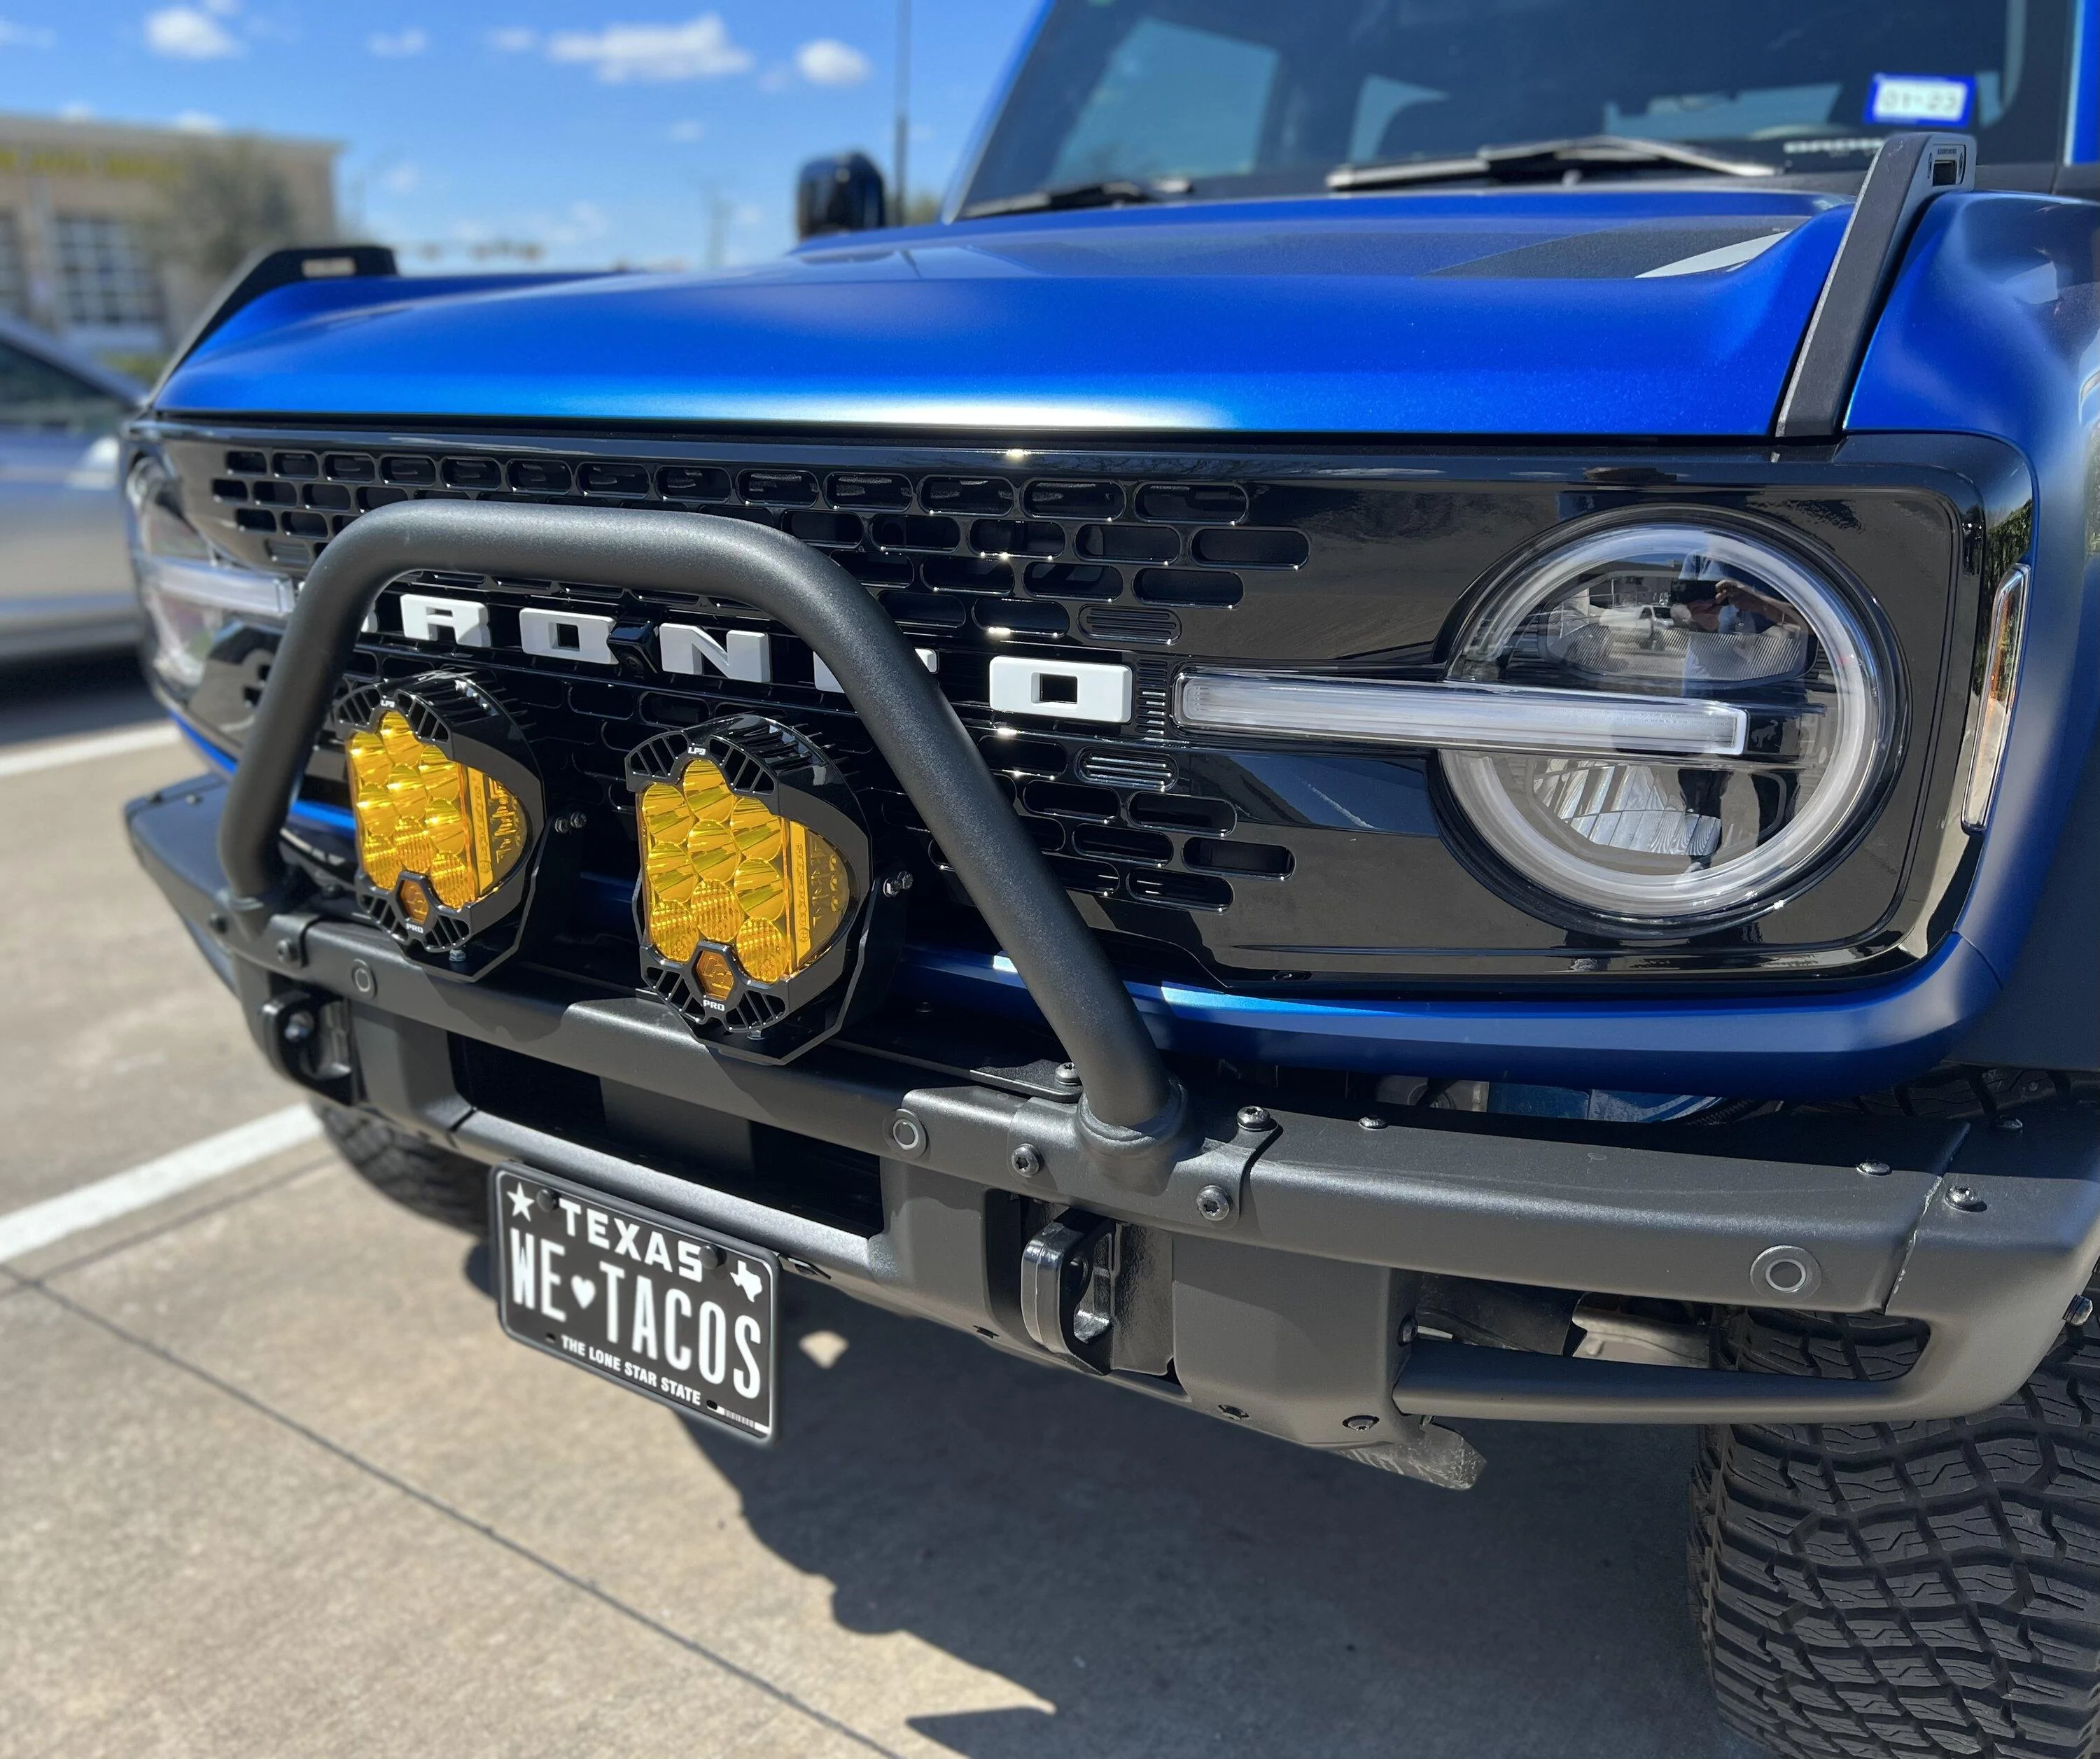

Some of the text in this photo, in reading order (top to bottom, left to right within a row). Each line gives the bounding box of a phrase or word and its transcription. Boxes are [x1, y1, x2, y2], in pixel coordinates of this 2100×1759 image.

[360, 594, 1133, 722] RONO
[687, 746, 706, 755] LP9
[406, 923, 424, 934] PRO
[703, 1000, 724, 1011] PRO
[559, 1197, 703, 1283] TEXAS
[510, 1227, 762, 1400] WE TACOS
[561, 1335, 702, 1407] THE LONE STAR STATE
